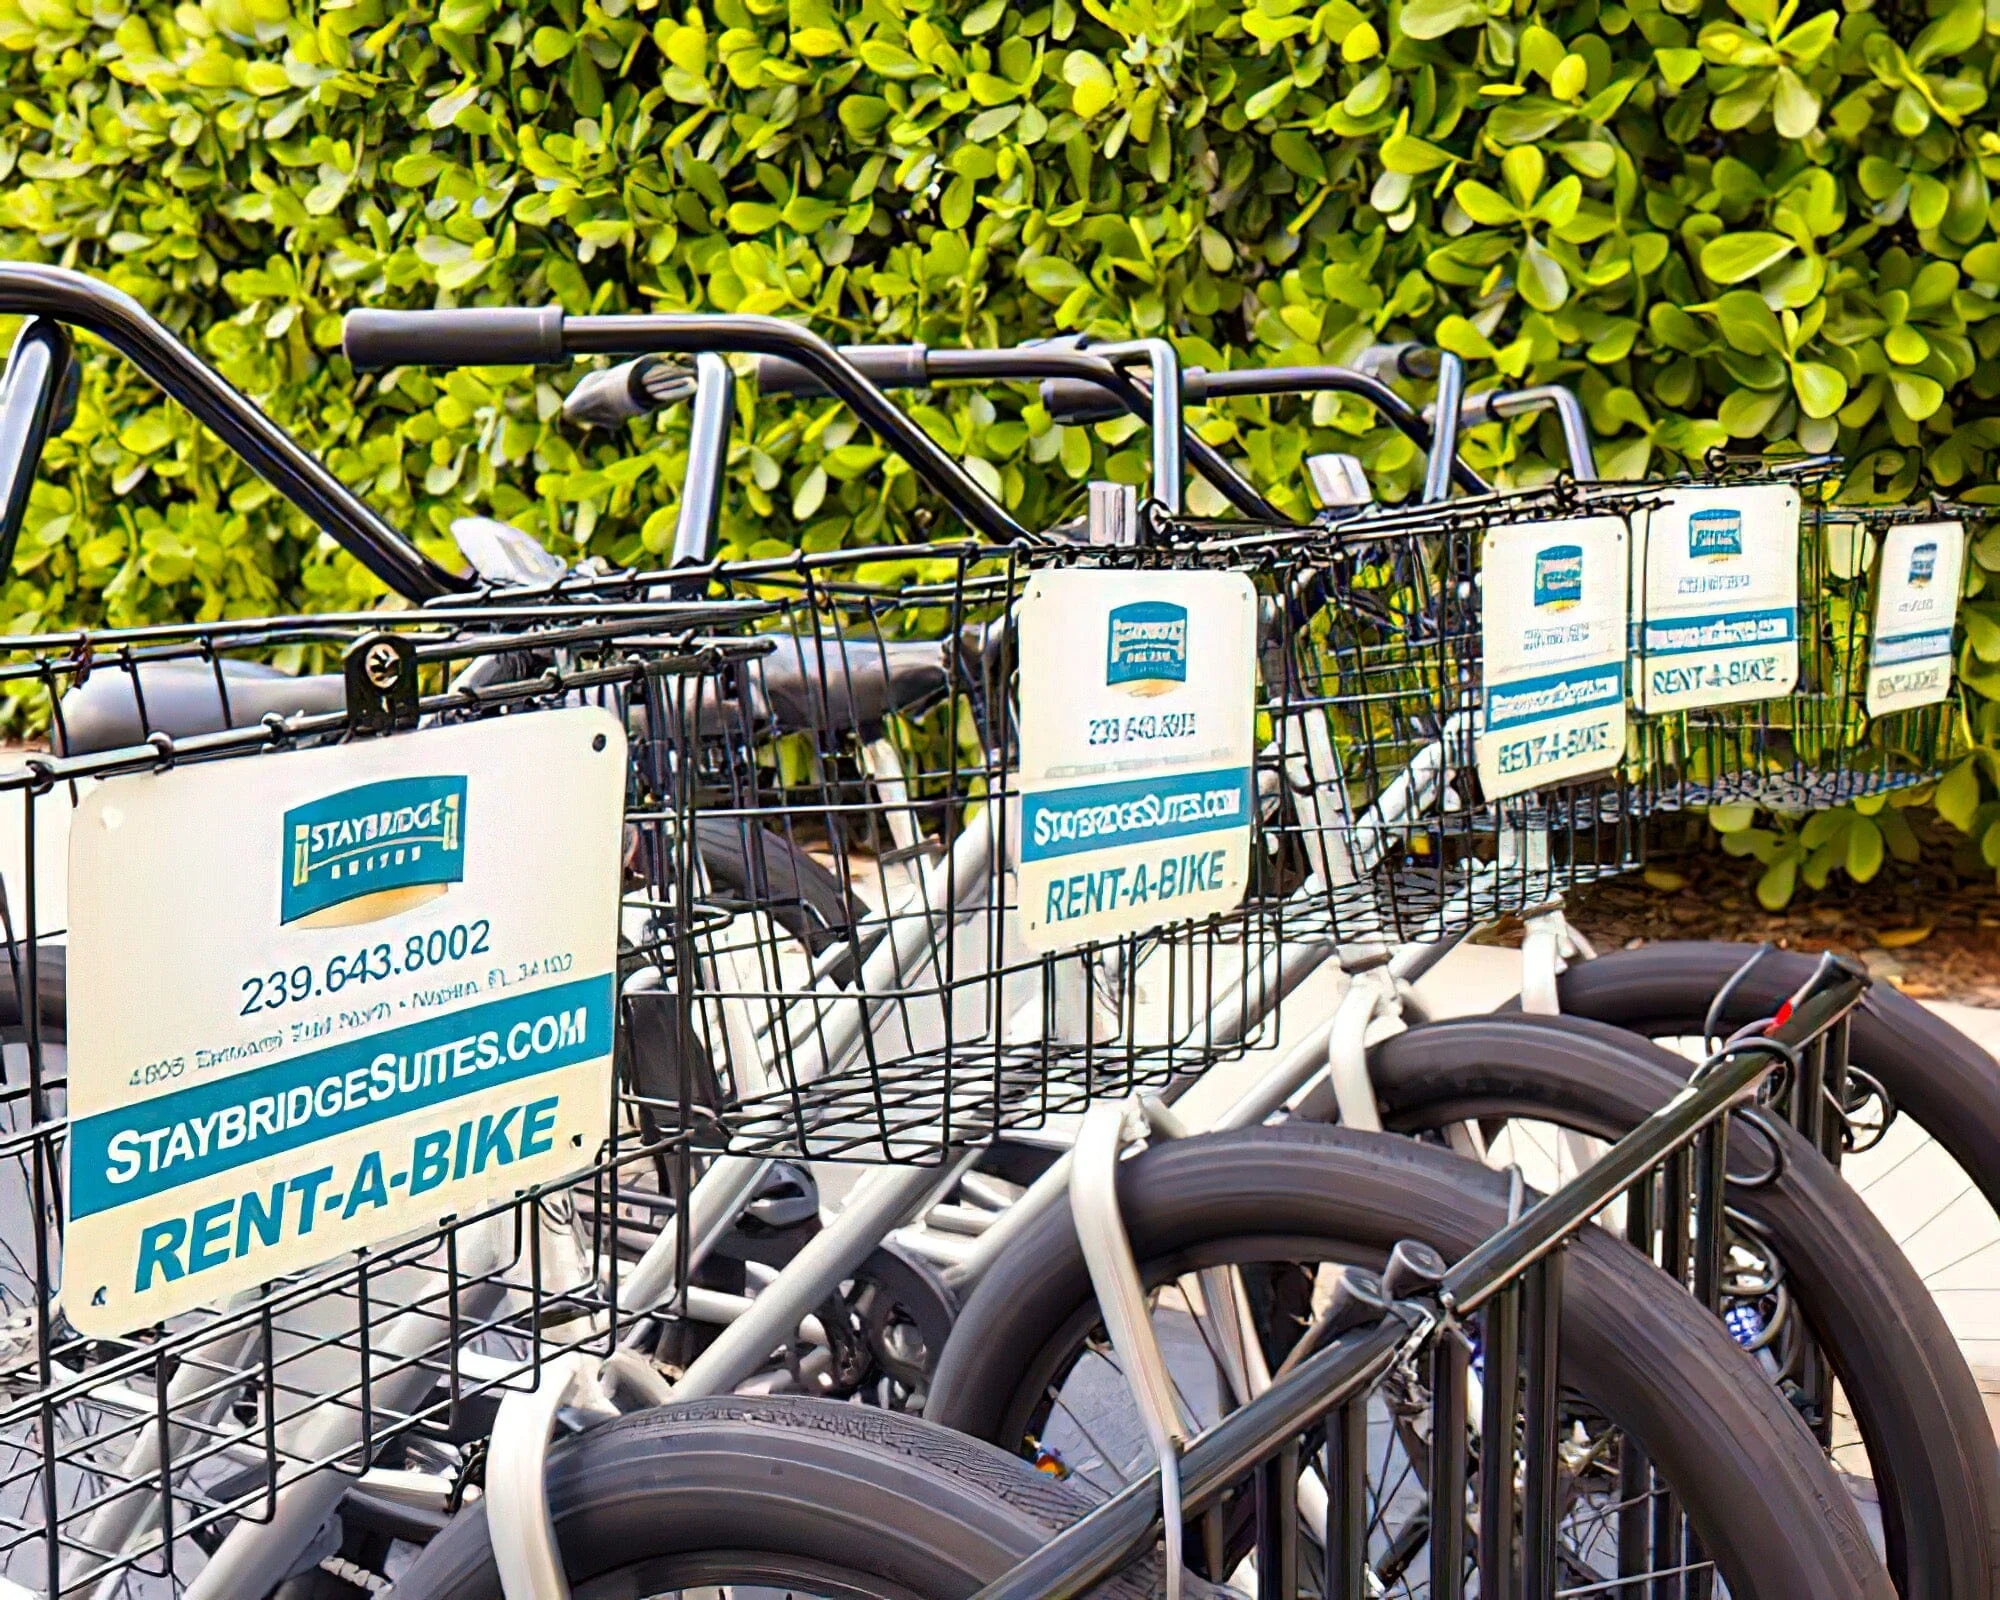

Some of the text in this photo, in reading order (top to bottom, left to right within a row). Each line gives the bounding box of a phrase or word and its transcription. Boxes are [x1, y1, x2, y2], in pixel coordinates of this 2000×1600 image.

[1046, 849, 1226, 924] RENT-A-BIKE
[239, 918, 491, 1017] 239.643.8002
[133, 1095, 560, 1294] RENT-A-BIKE
